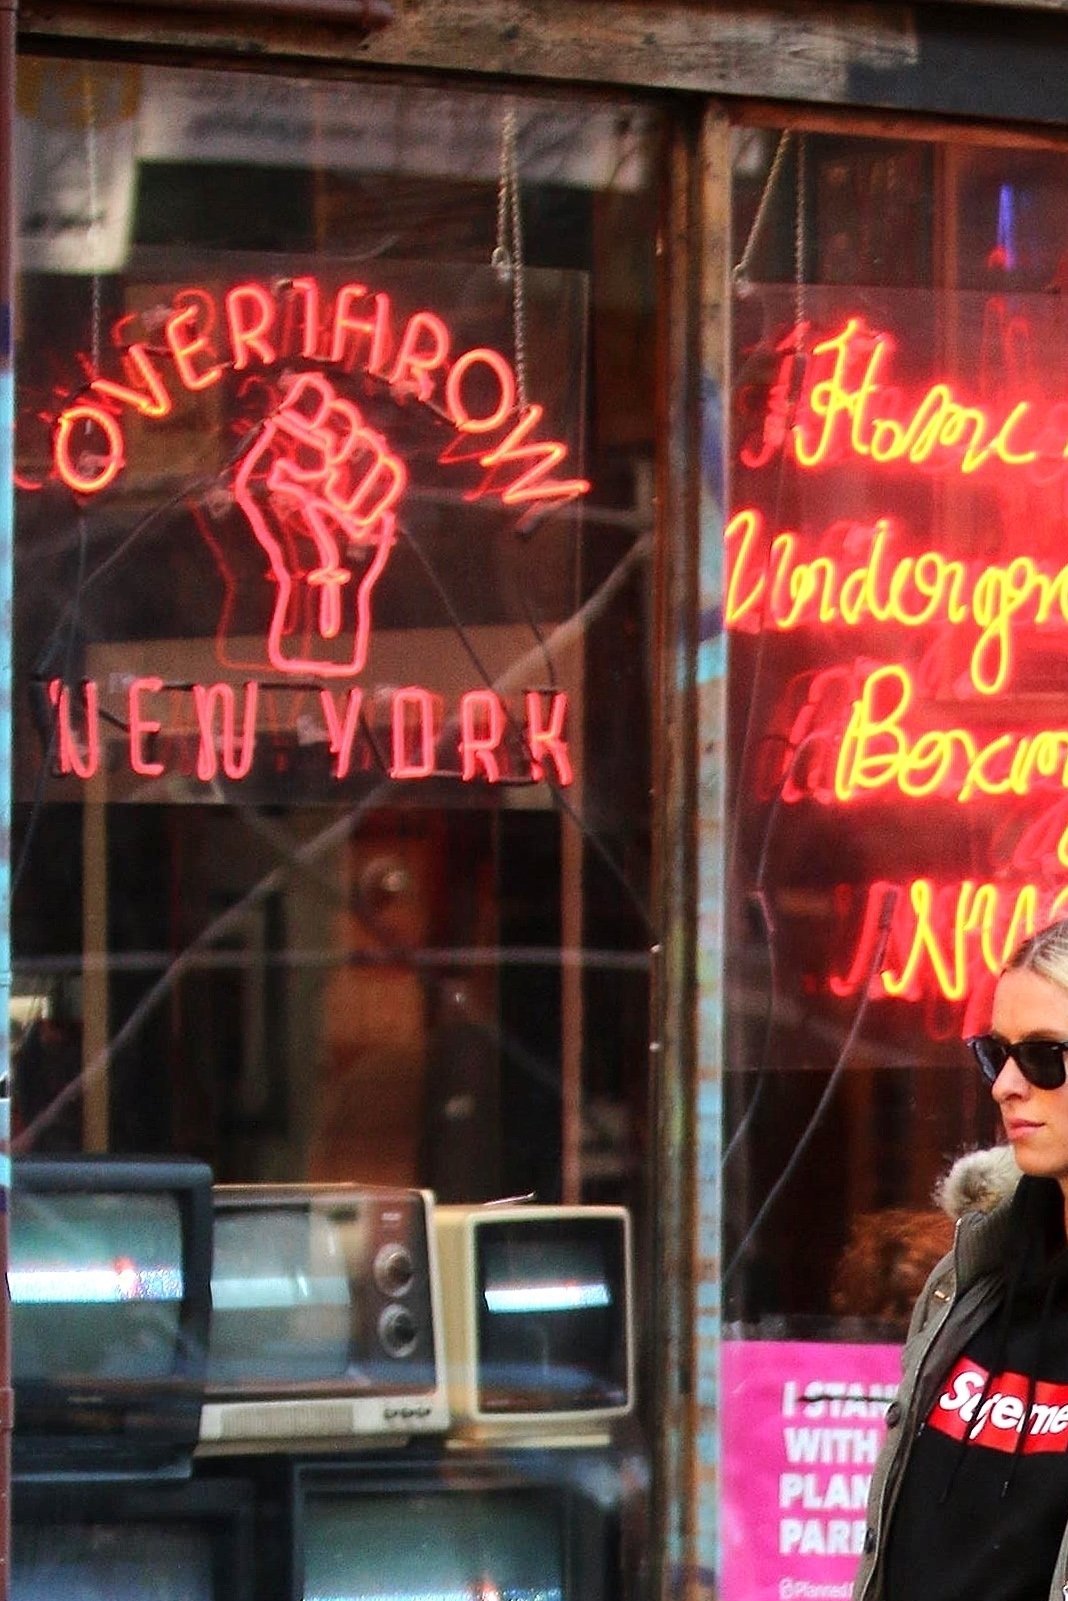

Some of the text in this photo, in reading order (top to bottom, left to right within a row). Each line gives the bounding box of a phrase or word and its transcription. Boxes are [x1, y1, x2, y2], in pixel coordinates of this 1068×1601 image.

[56, 277, 590, 503] OVERTHROW
[51, 676, 573, 786] NEW YORK
[782, 1380, 901, 1418] I STAN
[784, 1426, 879, 1464] WITH
[779, 1472, 872, 1510] PLAN
